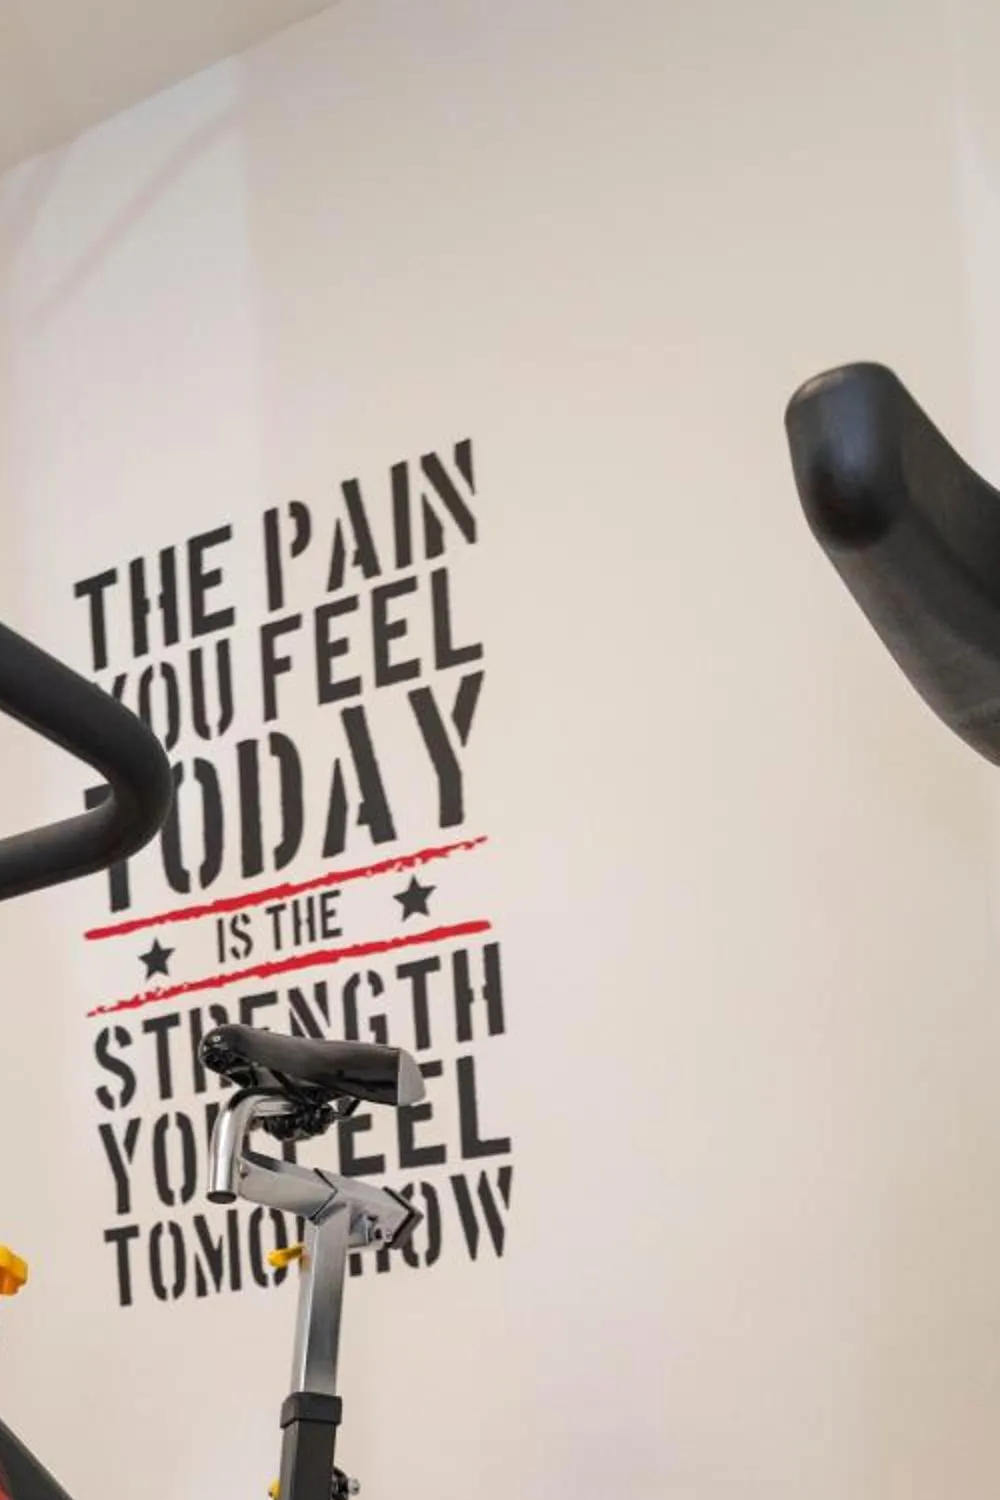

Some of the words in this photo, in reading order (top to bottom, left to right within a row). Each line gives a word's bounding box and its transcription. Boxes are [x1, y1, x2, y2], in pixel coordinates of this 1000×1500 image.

[73, 523, 236, 672] THE
[262, 437, 478, 613] PAIN
[94, 637, 235, 752] OU
[259, 565, 485, 723] FEEL
[216, 912, 254, 964] IS
[265, 889, 344, 952] THE
[280, 1055, 513, 1178] EEL
[103, 1165, 515, 1308] TOMOOW
